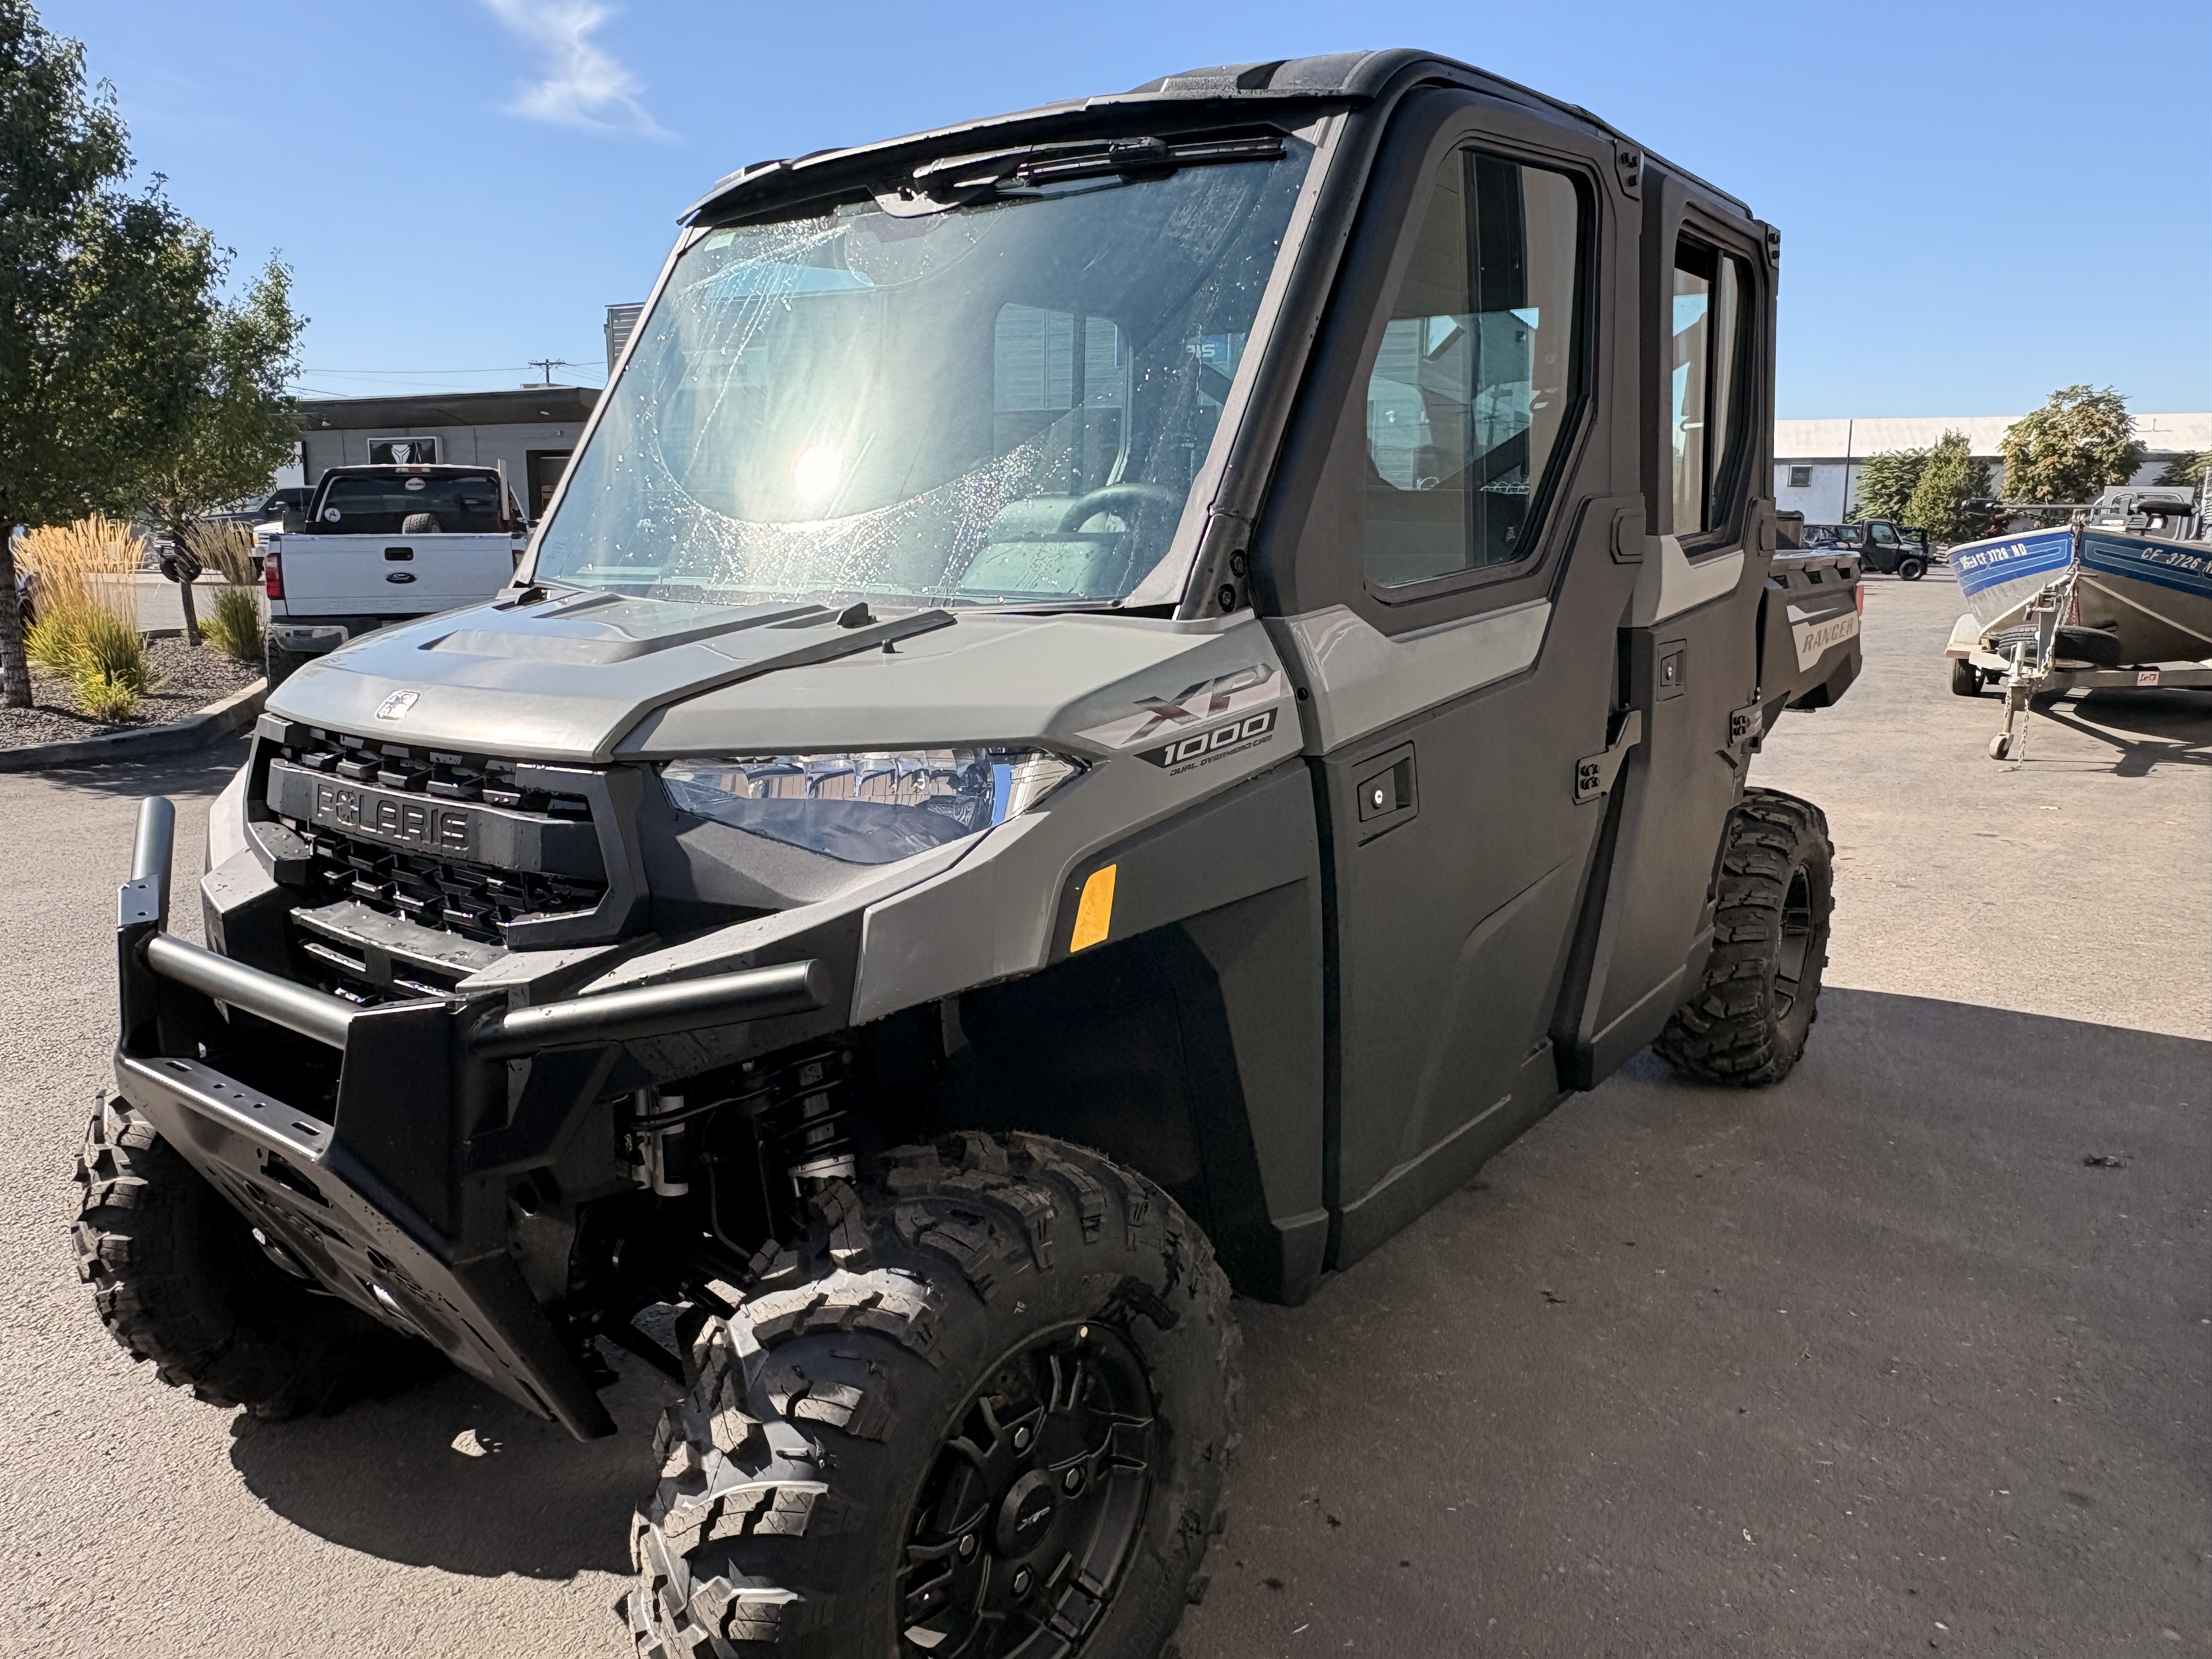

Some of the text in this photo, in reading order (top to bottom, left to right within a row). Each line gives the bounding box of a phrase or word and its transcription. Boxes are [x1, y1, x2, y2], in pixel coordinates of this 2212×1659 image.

[2141, 548, 2163, 560] CF
[2166, 552, 2202, 569] 3726
[1802, 618, 1854, 653] RANGER
[1120, 663, 1274, 745] XP
[1164, 712, 1270, 766] 1000
[317, 783, 469, 851] POLARIS
